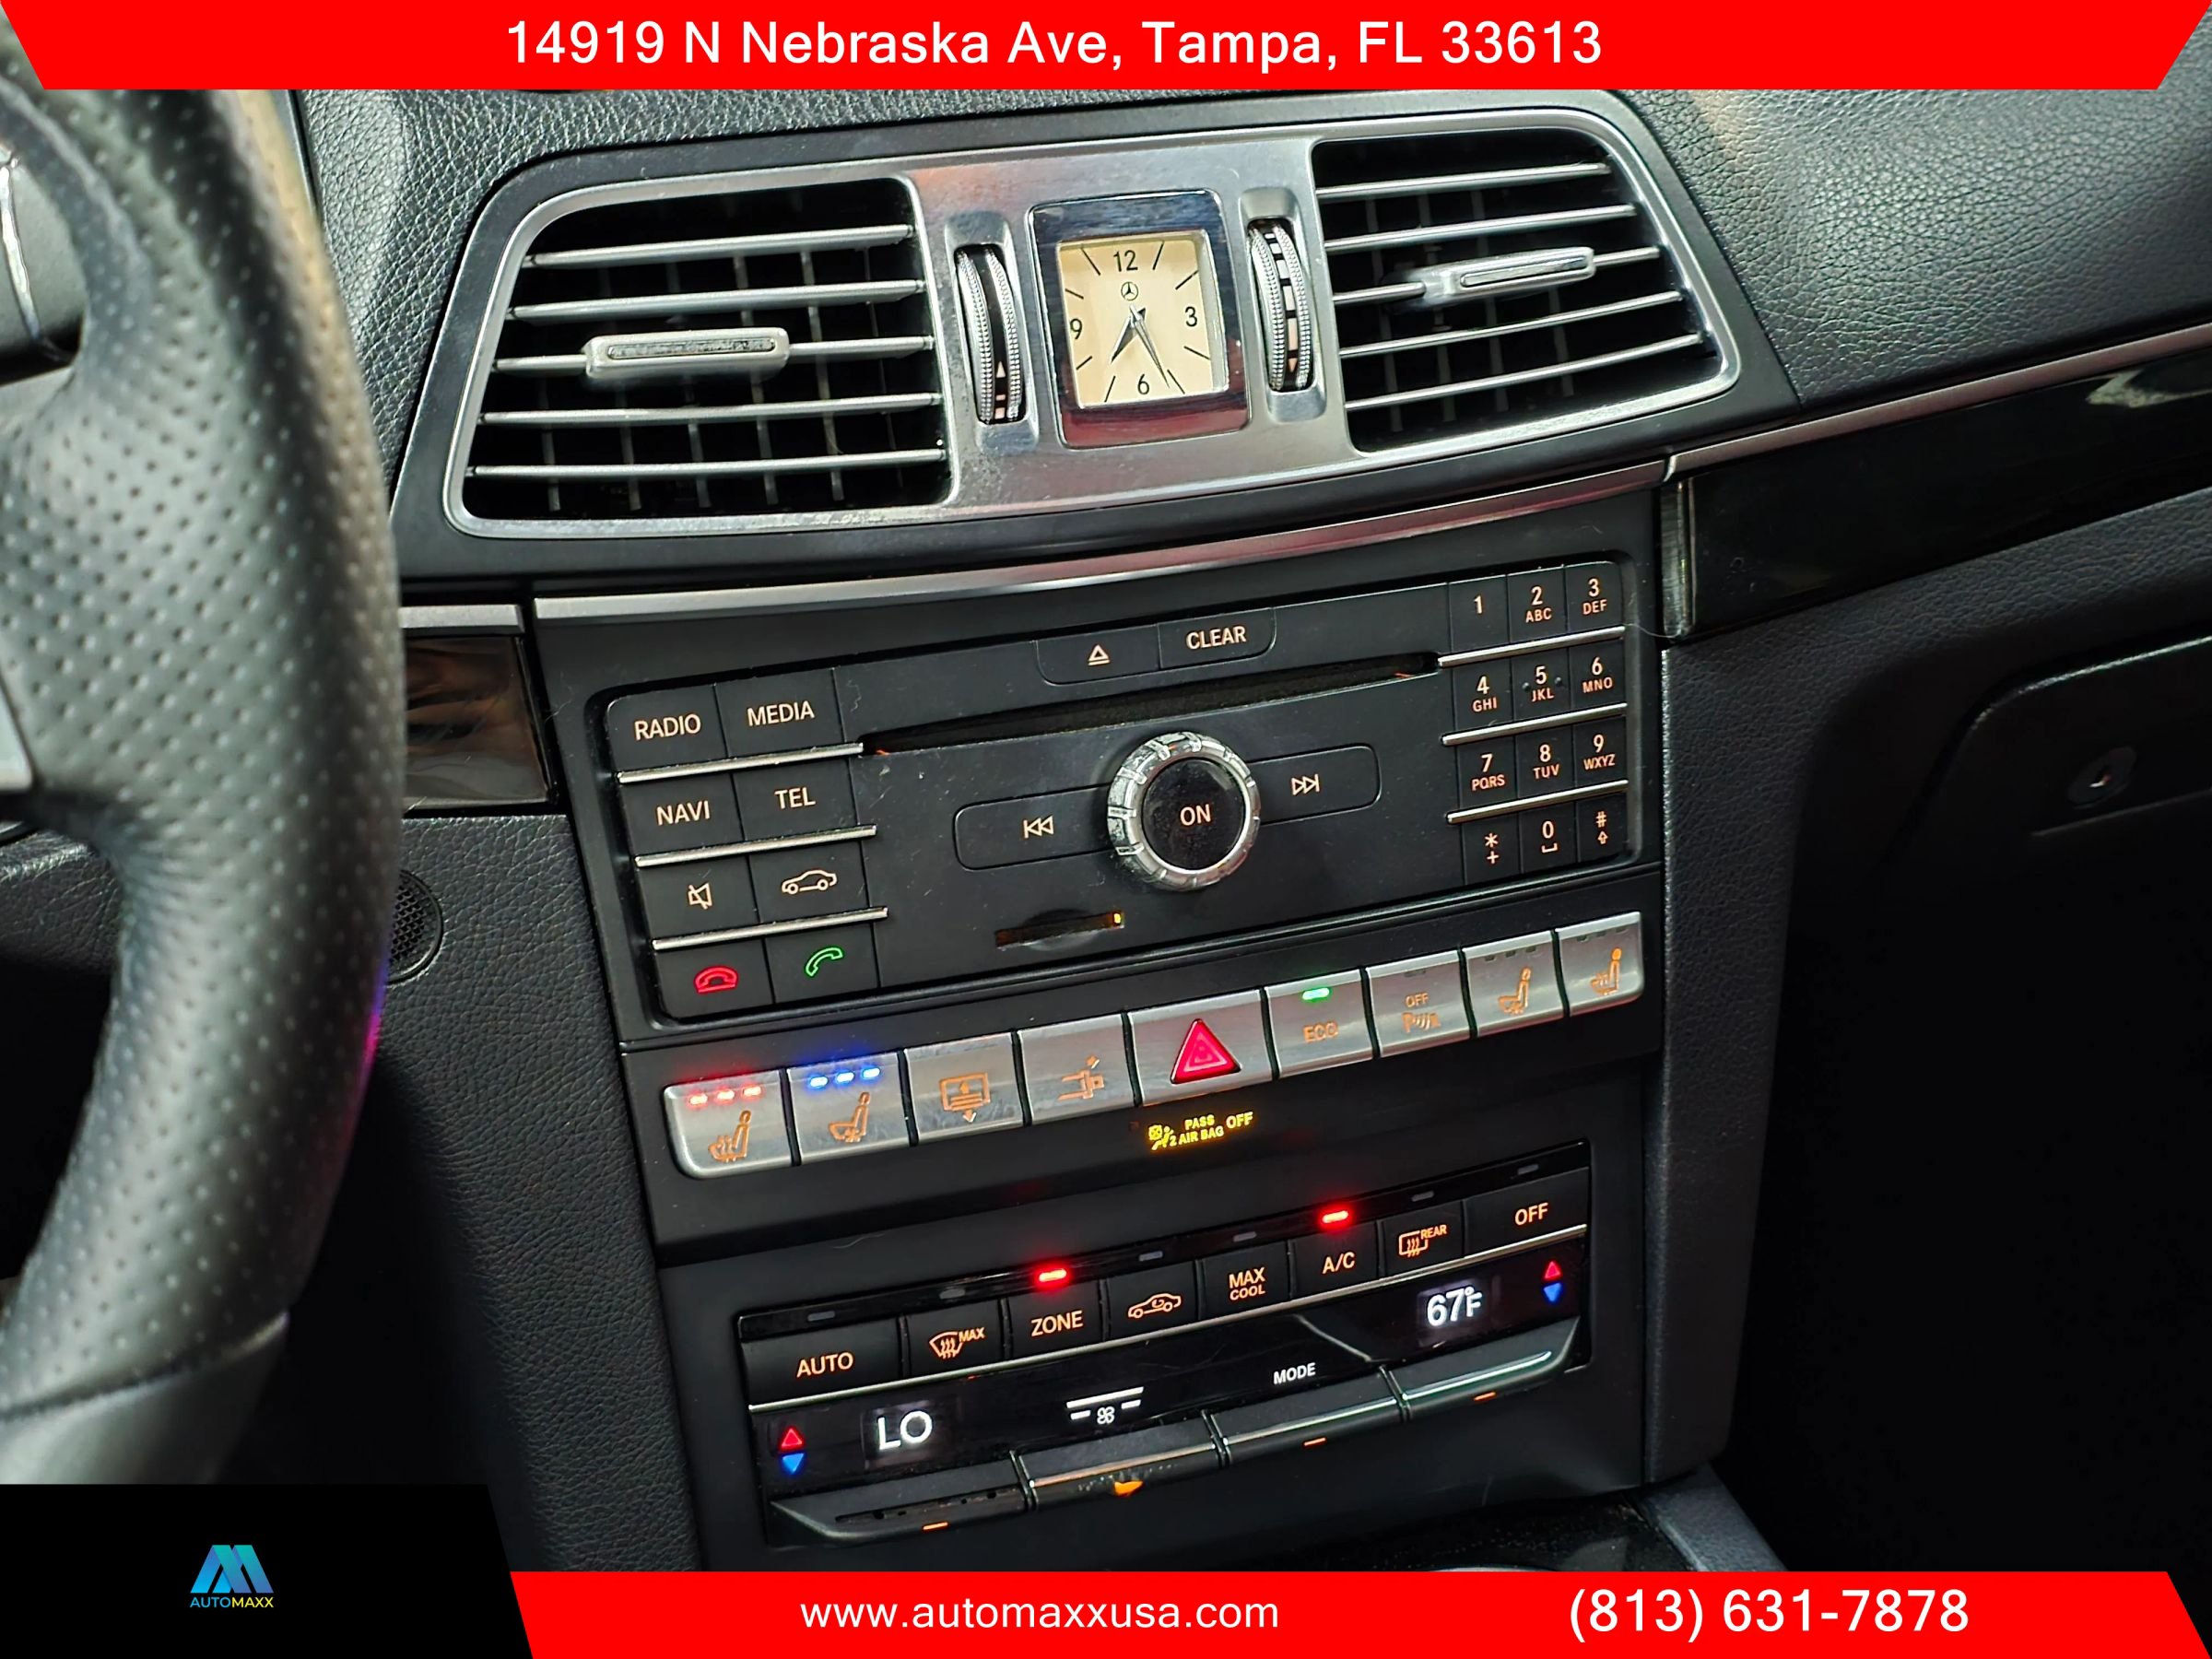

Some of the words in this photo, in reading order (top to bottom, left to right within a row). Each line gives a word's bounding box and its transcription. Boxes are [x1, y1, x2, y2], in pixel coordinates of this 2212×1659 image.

[1112, 249, 1139, 274] 12
[1183, 306, 1199, 328] 3
[1068, 318, 1084, 340] 9
[1135, 372, 1151, 396] 6
[1530, 585, 1544, 606] 2
[1587, 578, 1601, 598] 3
[1474, 594, 1484, 616] 1
[1525, 606, 1553, 624] ABC
[1582, 598, 1608, 616] DEF
[1185, 624, 1248, 651] CLEAR
[1535, 665, 1548, 686] 5
[1591, 655, 1605, 677] 6
[1476, 675, 1490, 696] 4
[1530, 688, 1556, 703] JKL
[1581, 676, 1615, 694] MNO
[747, 700, 816, 728] MEDIA
[1471, 696, 1499, 713] GHI
[633, 713, 702, 741] RADIO
[1538, 743, 1552, 764] 8
[1592, 733, 1606, 754] 9
[1480, 752, 1494, 774] 7
[1532, 763, 1561, 781] TUV
[1582, 752, 1617, 771] WXYZ
[1470, 773, 1507, 793] PQRS
[773, 786, 818, 811] TEL
[655, 799, 712, 826] NAVI
[1179, 803, 1212, 827] ON
[1405, 992, 1430, 1008] OFF
[1301, 1020, 1339, 1043] ECO
[1183, 1114, 1216, 1131] PASS
[1225, 1111, 1253, 1129] OFF
[1178, 1131, 1199, 1146] AIR
[1200, 1125, 1225, 1141] BAG
[1513, 1202, 1550, 1227] OFF
[1419, 1223, 1449, 1241] REAR
[1322, 1251, 1357, 1276] A/C
[1228, 1266, 1266, 1289] MAX
[1229, 1284, 1267, 1301] COOL
[1030, 1309, 1085, 1338] ZONE
[959, 1326, 986, 1344] MAX
[795, 1351, 854, 1379] AUTO
[1272, 1362, 1317, 1386] MODE
[877, 1409, 934, 1453] LO
